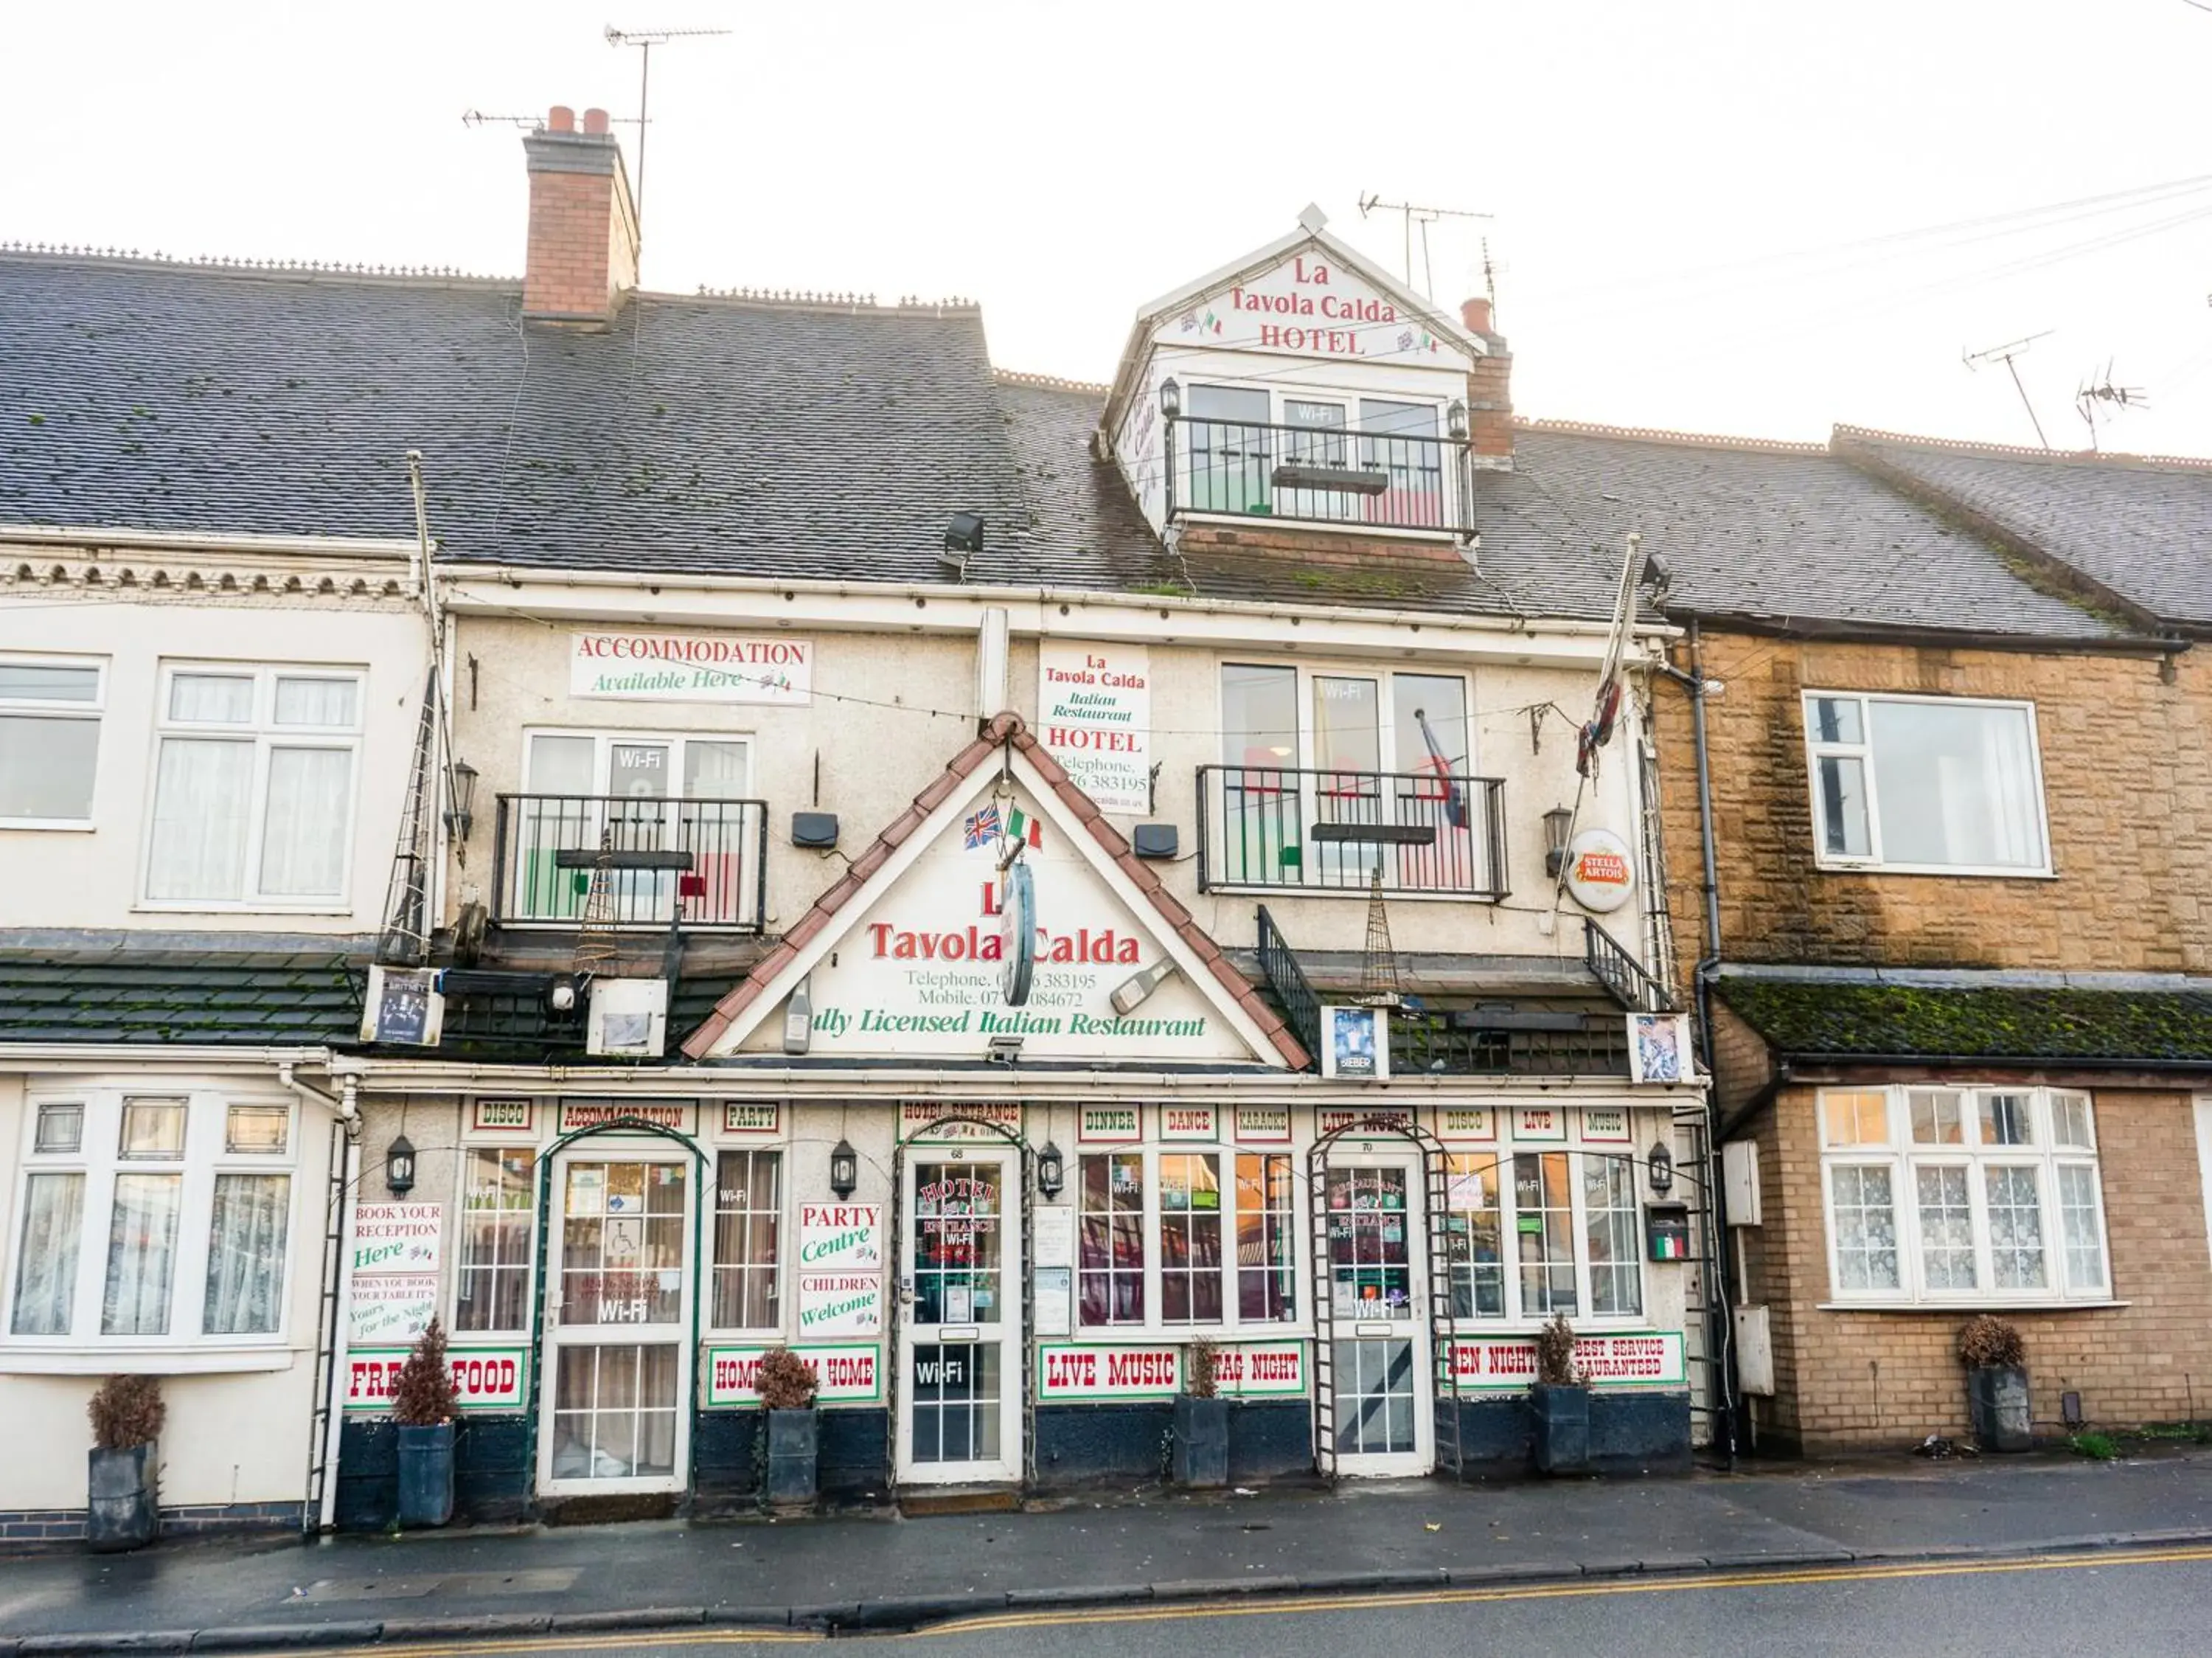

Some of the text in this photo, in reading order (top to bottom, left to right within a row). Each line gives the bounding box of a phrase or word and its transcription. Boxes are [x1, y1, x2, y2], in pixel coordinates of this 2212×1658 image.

[1295, 257, 1329, 285] La
[1230, 287, 1395, 322] Tavola Calda
[1260, 325, 1364, 355] HOTEL
[1298, 405, 1332, 422] Wi-Fi
[578, 637, 806, 665] ACCOMMODATION
[1087, 654, 1106, 668] La
[591, 671, 742, 691] Available Here
[1046, 667, 1145, 689] Tavola Calda
[1070, 692, 1116, 706] Italian
[1326, 683, 1362, 700] Wi-Fi
[1052, 705, 1132, 721] Restaurant
[1048, 726, 1142, 752] HOTEL
[620, 749, 661, 769] Wi-Fi
[1090, 776, 1147, 791] 383195
[1585, 858, 1622, 867] STELLA
[1585, 868, 1623, 878] ARTOIS
[980, 882, 1002, 917] L
[868, 923, 1003, 960] Tavola
[1047, 973, 1096, 988] 383195
[1032, 991, 1082, 1007] 084672
[810, 1007, 1206, 1038] ully Licensed Italian Restaurant
[483, 1103, 524, 1123] DISCO
[729, 1106, 775, 1126] PARTY
[1085, 1111, 1135, 1130] DINNER
[1168, 1111, 1210, 1130] DANCE
[1238, 1111, 1287, 1131] KARAOKE
[1447, 1111, 1483, 1130] DISCO
[1524, 1111, 1551, 1129] LIVE
[1587, 1113, 1622, 1131] MUSIC
[720, 1190, 746, 1203] Wi-Fi
[920, 1178, 995, 1204] HOTEL
[1113, 1181, 1139, 1193] Wi-Fi
[356, 1205, 440, 1220] BOOK YOUR
[802, 1205, 880, 1227] PARTY
[355, 1224, 437, 1237] RECEPTION
[802, 1227, 870, 1263] Centre
[354, 1242, 403, 1269] Here
[352, 1278, 435, 1288] WHEN YOU BOOK
[802, 1277, 879, 1292] CHILDREN
[352, 1291, 380, 1301] YOUR
[383, 1291, 414, 1300] TABLE
[349, 1303, 385, 1322] Yours
[358, 1300, 433, 1339] for the Night
[599, 1300, 647, 1321] Wi-Fi
[801, 1292, 875, 1327] Welcome
[1576, 1339, 1664, 1357] BEST SERVICE
[1048, 1353, 1175, 1387] LIVE MUSIC
[1211, 1353, 1298, 1380] TAG NIGHT
[1488, 1346, 1537, 1374] NIGHT
[1576, 1359, 1662, 1377] GAURANTEED
[350, 1360, 515, 1396] FRE FOOD
[827, 1357, 873, 1387] HOME
[917, 1362, 961, 1384] Wi-Fi
